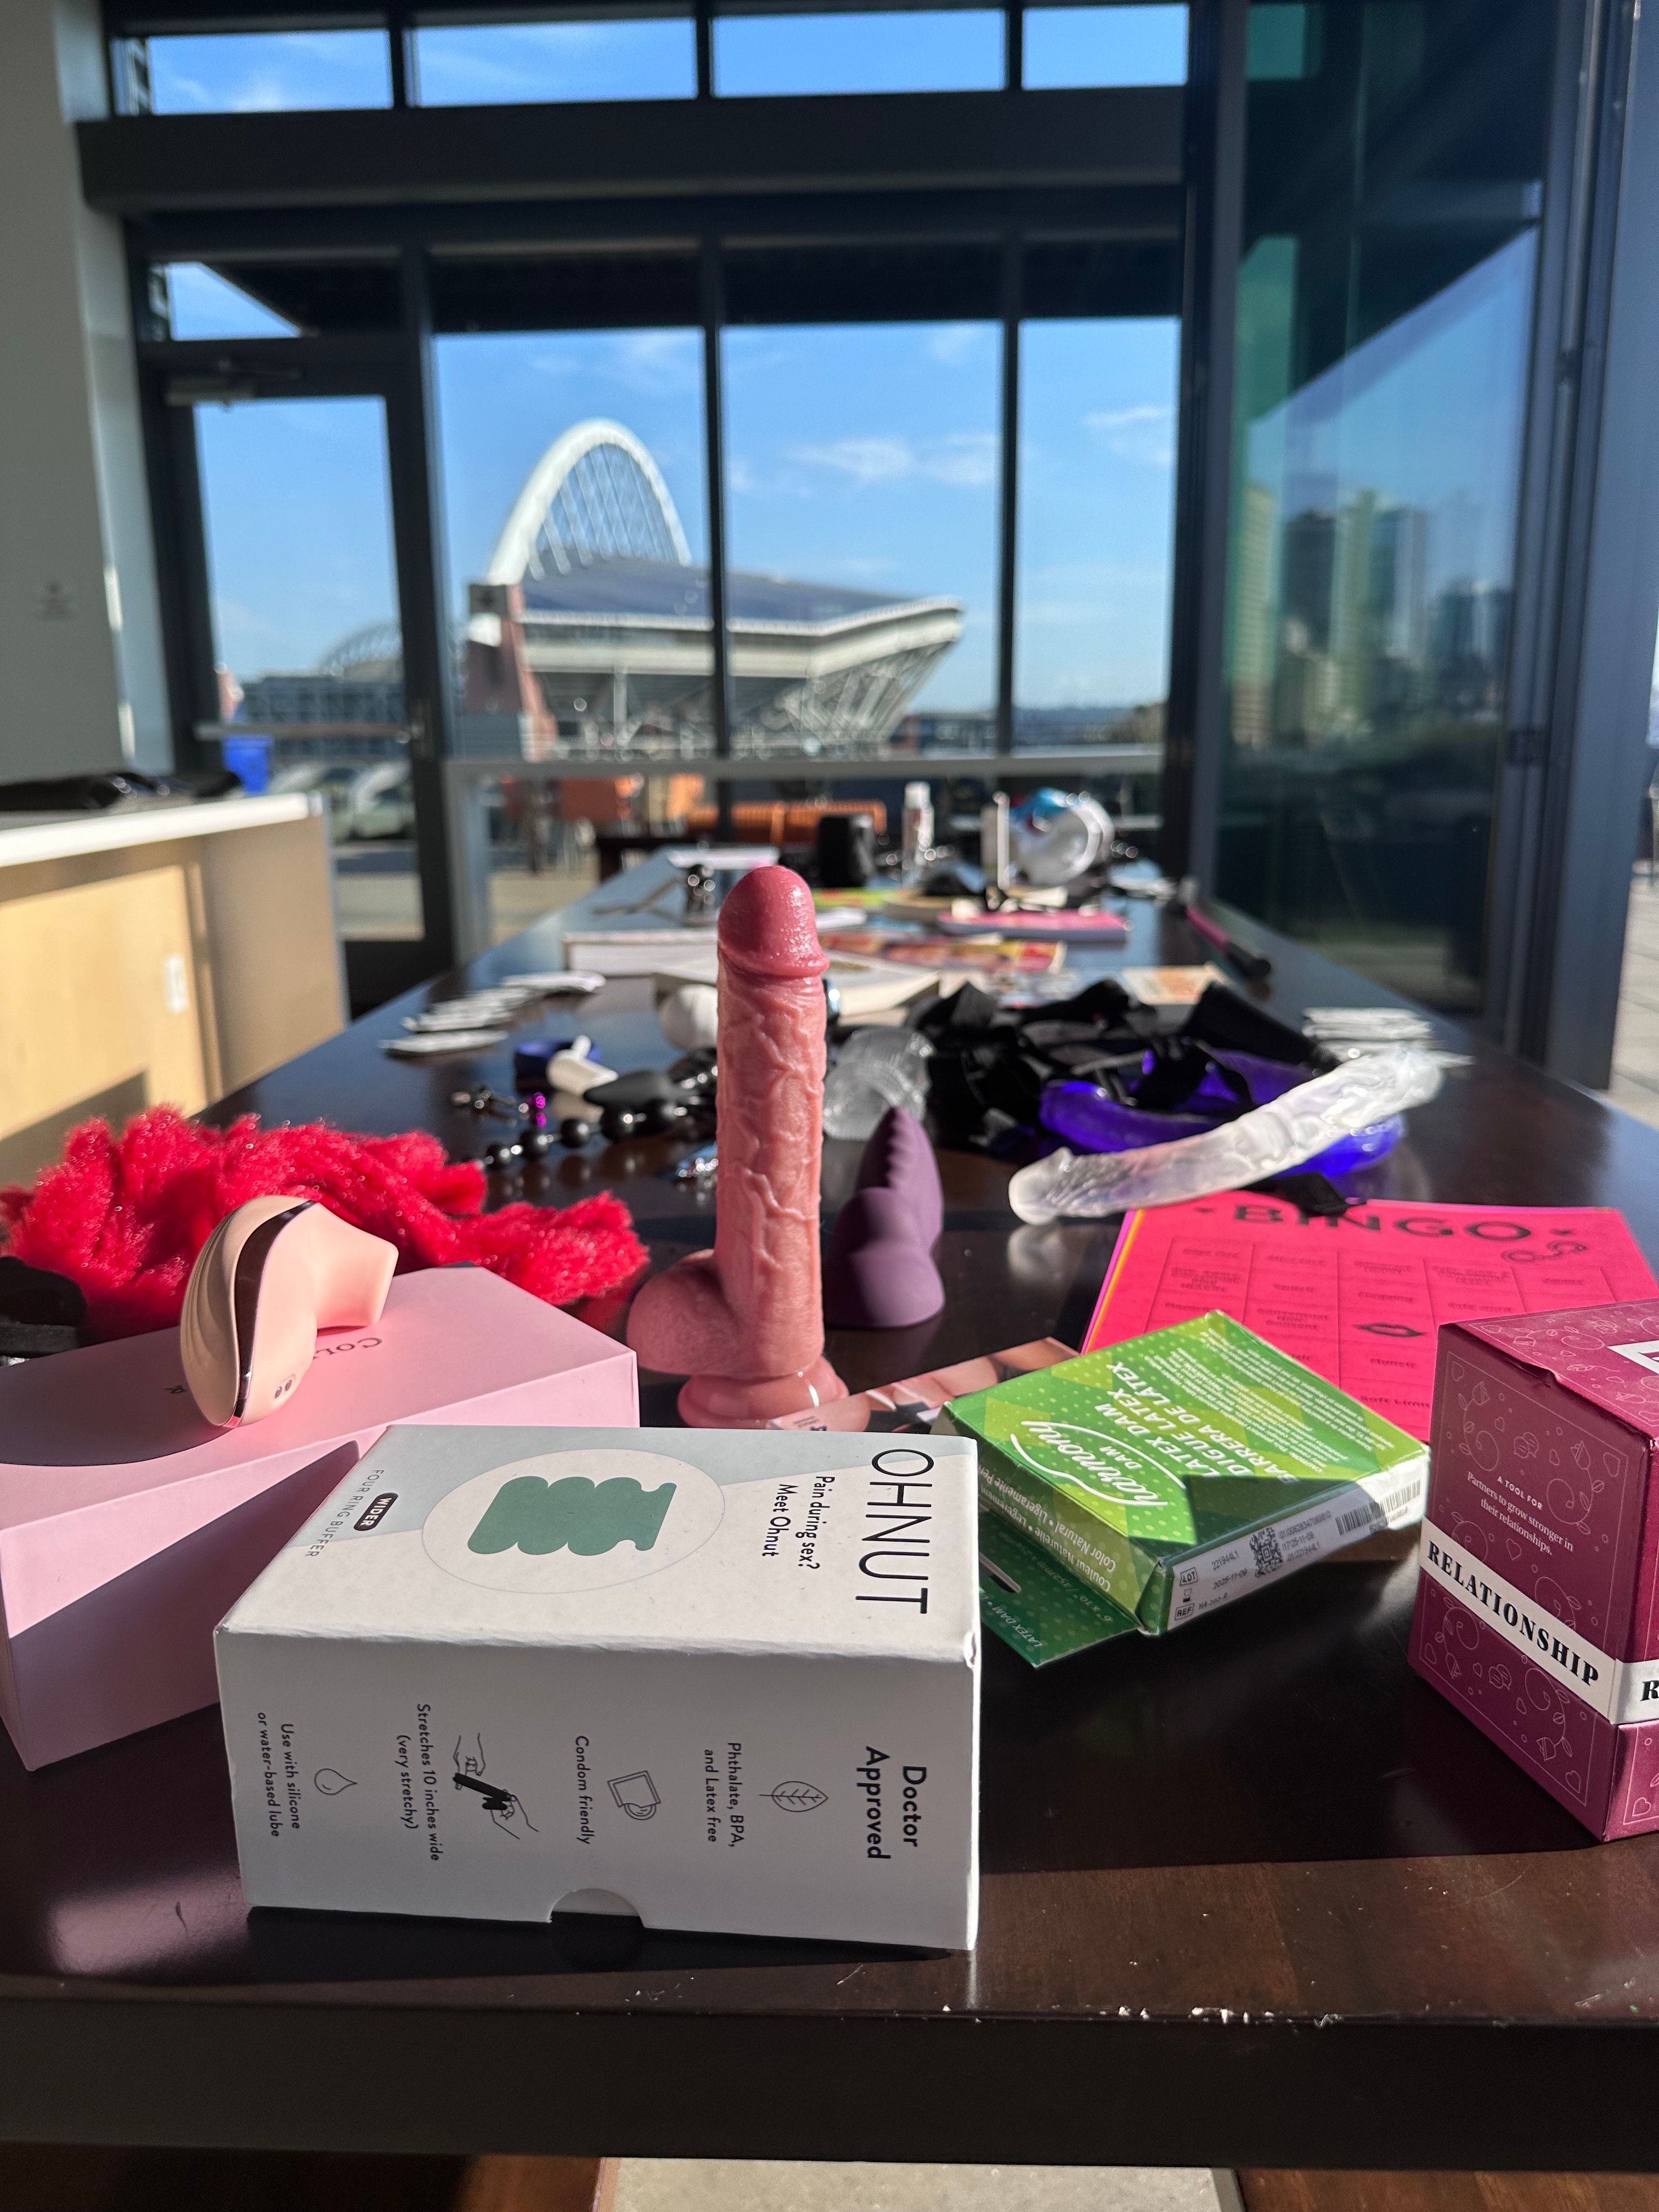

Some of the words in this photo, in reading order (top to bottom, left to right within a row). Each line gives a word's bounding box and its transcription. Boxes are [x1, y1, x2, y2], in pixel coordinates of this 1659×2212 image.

[1232, 1204, 1532, 1242] BINGO
[1094, 1403, 1151, 1436] DAM
[1107, 1388, 1177, 1430] LATEX
[1164, 1406, 1201, 1424] DE
[1021, 1421, 1168, 1505] harmony
[1099, 1446, 1142, 1470] DAM
[1144, 1436, 1220, 1477] LATEX
[1171, 1431, 1252, 1476] DIGUE
[1198, 1424, 1299, 1483] BARRERA
[357, 1470, 385, 1492] FOUR
[772, 1484, 799, 1512] Meet
[811, 1476, 835, 1498] Pain
[1497, 1476, 1503, 1484] A
[1505, 1480, 1525, 1499] TOOL
[1527, 1494, 1543, 1511] FOR
[337, 1496, 364, 1517] RING
[360, 1497, 392, 1526] WIDER
[795, 1502, 830, 1539] during
[1467, 1471, 1498, 1500] Partners
[1498, 1494, 1507, 1506] to
[1507, 1502, 1528, 1520] grow
[1528, 1516, 1564, 1545] stronger
[1564, 1538, 1574, 1552] in
[305, 1521, 343, 1556] BUFFER
[762, 1516, 791, 1556] Ohnut
[855, 1449, 934, 1614] OHNUT
[1054, 1520, 1091, 1555] Natural
[1481, 1498, 1499, 1518] their
[1499, 1512, 1553, 1555] relationships.
[798, 1542, 820, 1570] sex?
[1034, 1526, 1075, 1564] Naturelle
[1090, 1547, 1116, 1573] Color
[1076, 1559, 1111, 1593] Couleur
[1182, 1571, 1197, 1583] LOT
[992, 1606, 1016, 1624] DAM
[1177, 1607, 1192, 1617] REF
[1427, 1539, 1599, 1686] RELATIONSHIP
[1013, 1623, 1043, 1647] LATEX
[257, 1712, 267, 1726] or
[281, 1723, 294, 1748] Use
[417, 1703, 435, 1766] Stretches
[259, 1729, 281, 1807] water-based
[284, 1751, 299, 1779] with
[394, 1734, 411, 1768] (very
[575, 1735, 591, 1791] Condom
[704, 1749, 720, 1773] and
[422, 1770, 437, 1785] 10
[726, 1742, 743, 1810] Phthalate,
[287, 1782, 302, 1829] silicone
[399, 1772, 419, 1829] stretchy)
[425, 1789, 440, 1829] inches
[705, 1778, 720, 1813] Latex
[856, 1746, 891, 1859] Approved
[902, 1765, 927, 1847] Doctor
[268, 1810, 284, 1837] lube
[576, 1795, 595, 1844] friendly
[707, 1816, 721, 1842] free
[728, 1814, 745, 1847] BPA,
[429, 1833, 443, 1861] wide
